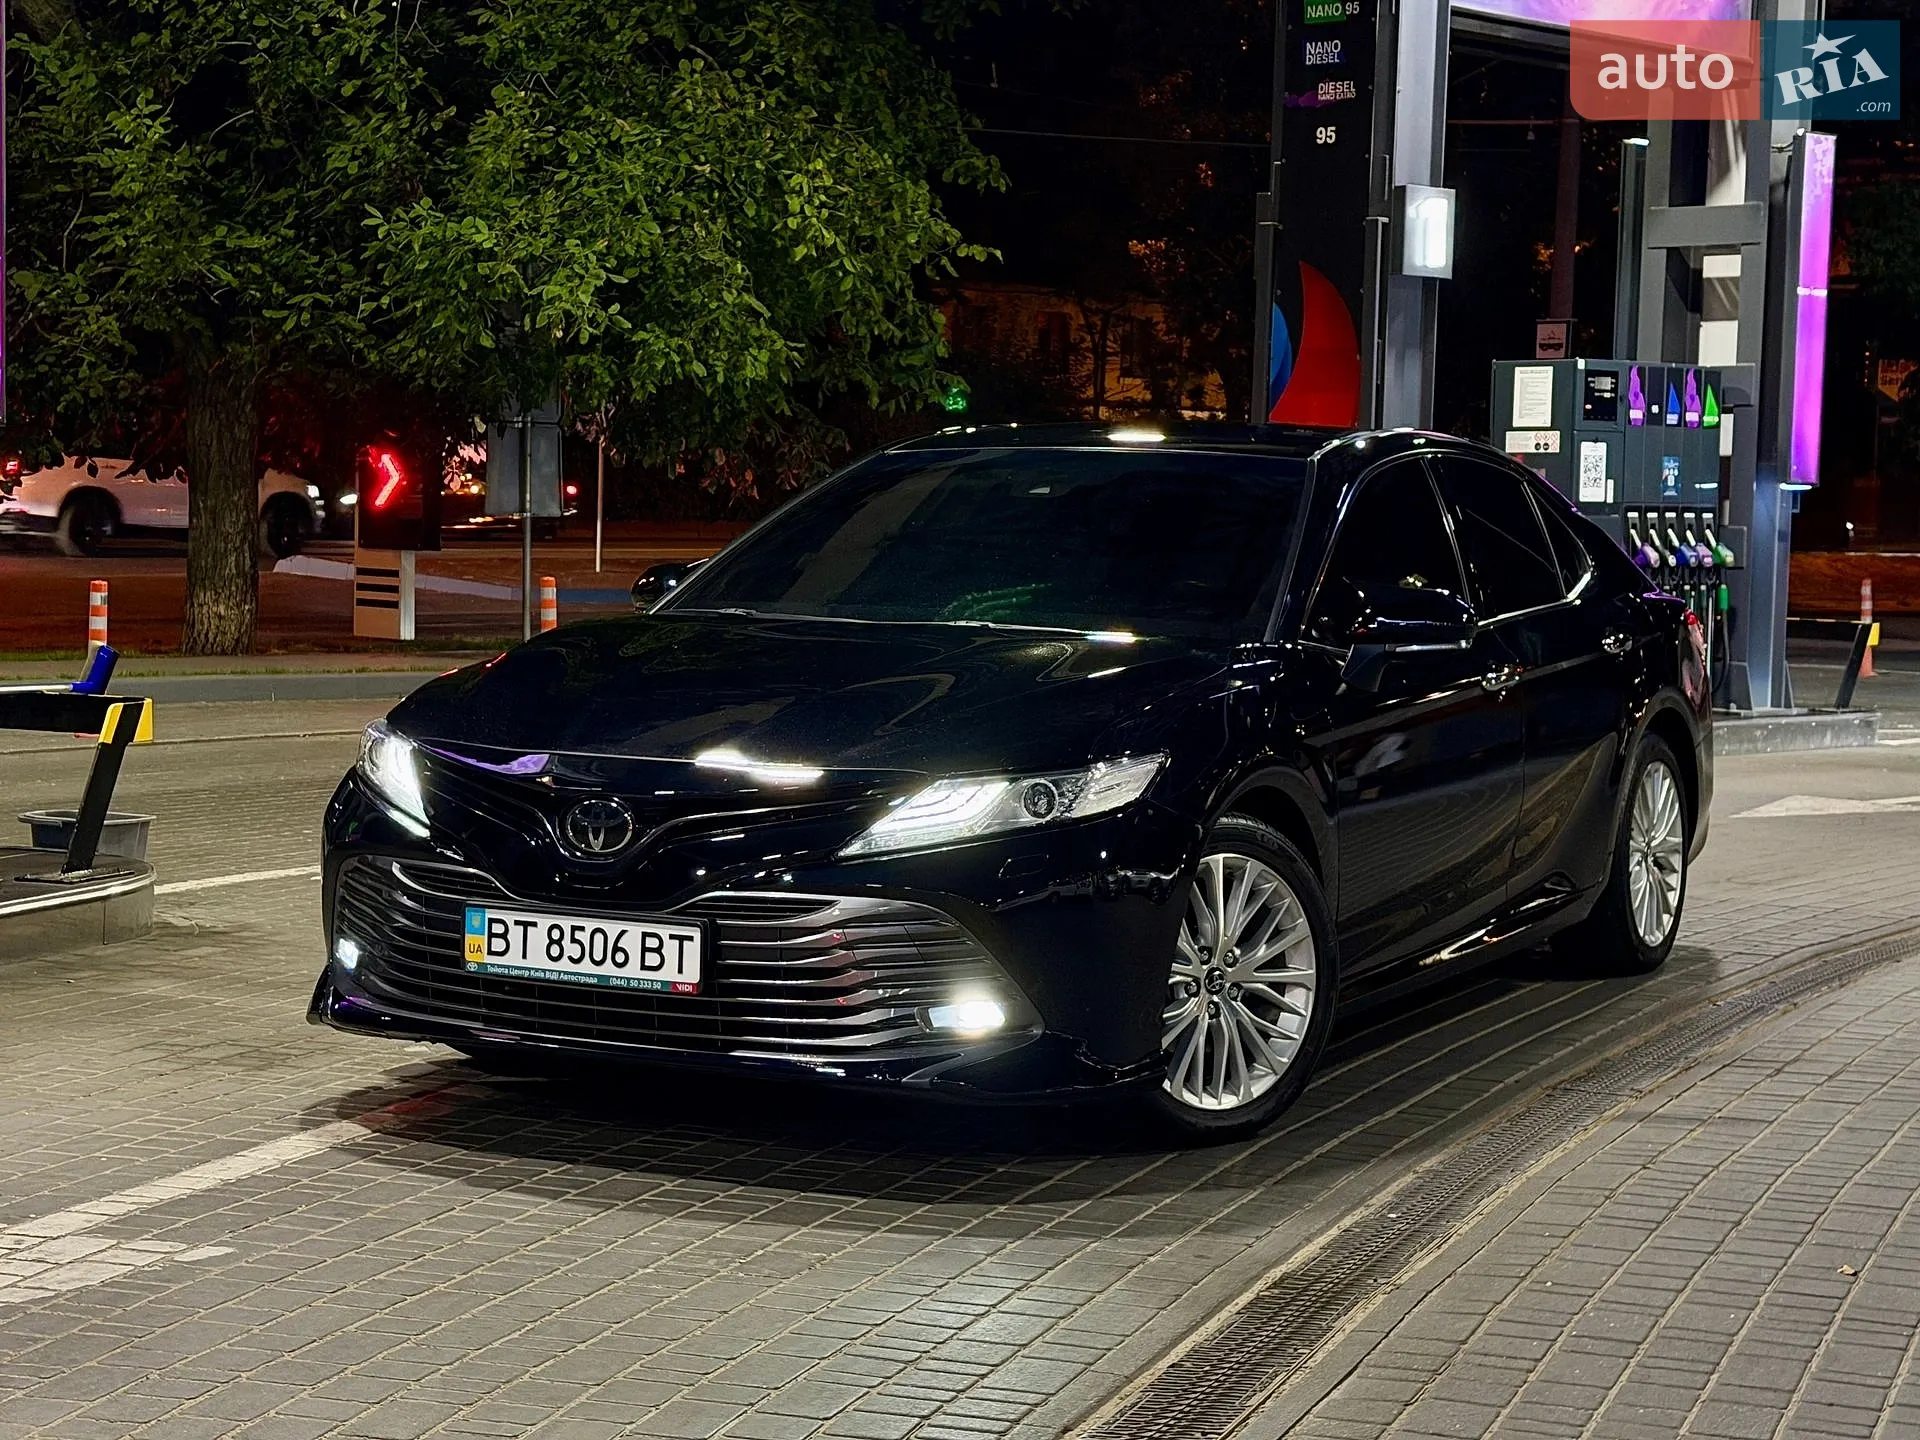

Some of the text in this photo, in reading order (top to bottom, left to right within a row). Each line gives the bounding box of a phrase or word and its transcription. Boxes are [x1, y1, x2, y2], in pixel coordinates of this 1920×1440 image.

[1306, 1, 1360, 19] NANO 95
[1306, 40, 1341, 55] NANO
[1305, 52, 1340, 65] DIESEL
[1318, 80, 1356, 94] DIESEL
[1315, 126, 1336, 144] 95
[468, 944, 483, 954] UA
[487, 917, 694, 975] BT 8506 BT
[487, 965, 509, 974] Тойота
[509, 967, 530, 978] Центр
[559, 972, 598, 984] Автострада
[609, 977, 628, 987] (044)
